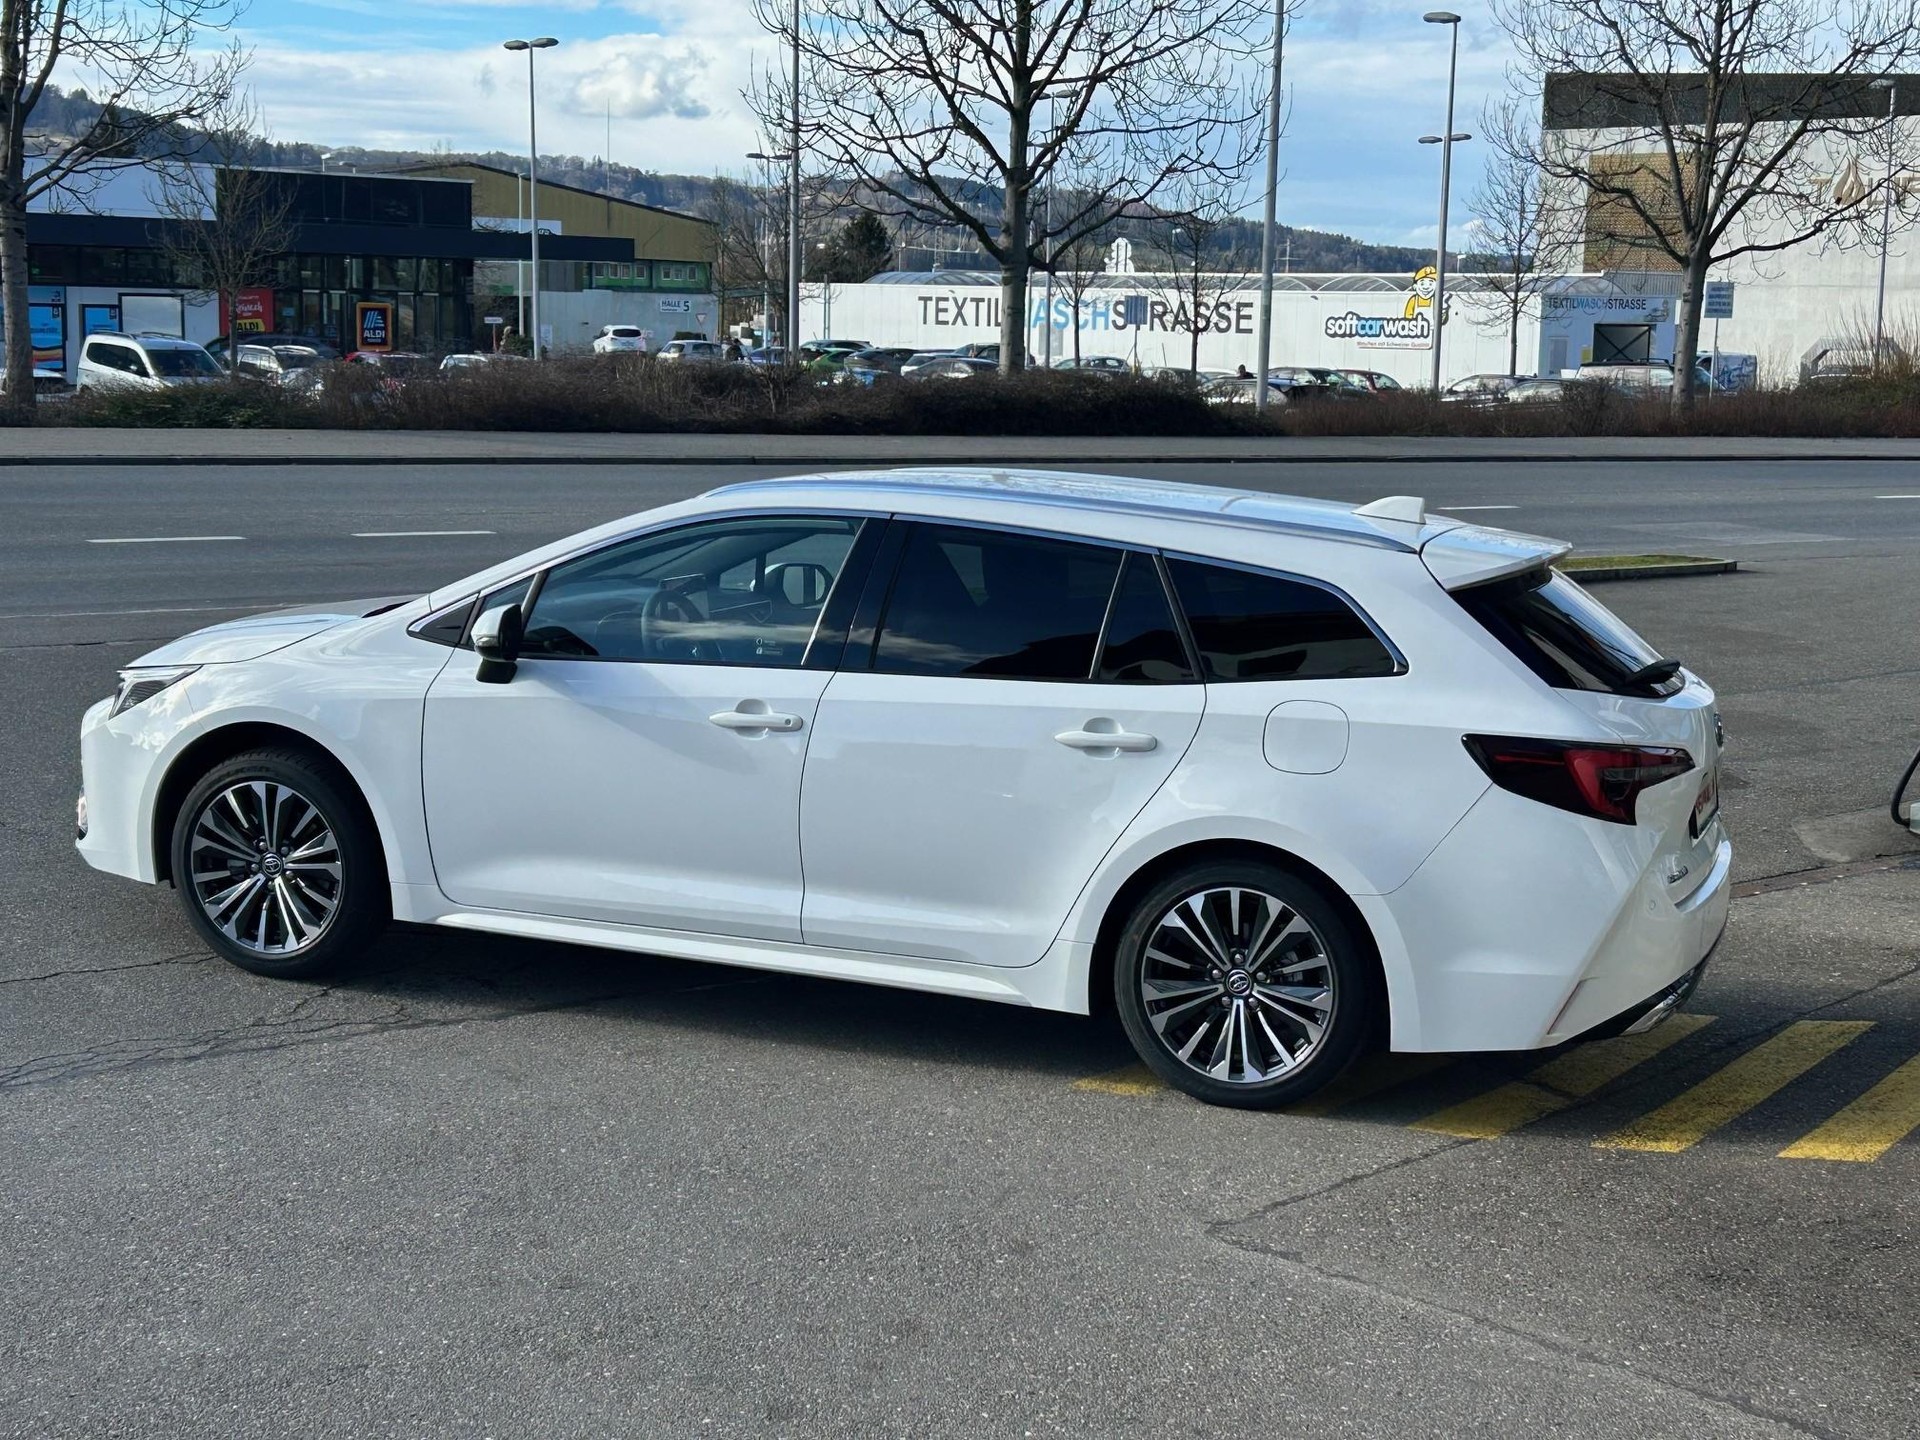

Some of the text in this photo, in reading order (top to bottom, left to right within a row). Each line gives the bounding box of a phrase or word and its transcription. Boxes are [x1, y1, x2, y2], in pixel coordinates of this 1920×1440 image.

[683, 300, 690, 311] 5
[918, 296, 1254, 334] TEXTILASCHSRASSE
[237, 321, 260, 331] ALDI
[1326, 312, 1430, 338] softcarwash
[363, 330, 386, 338] ALDI
